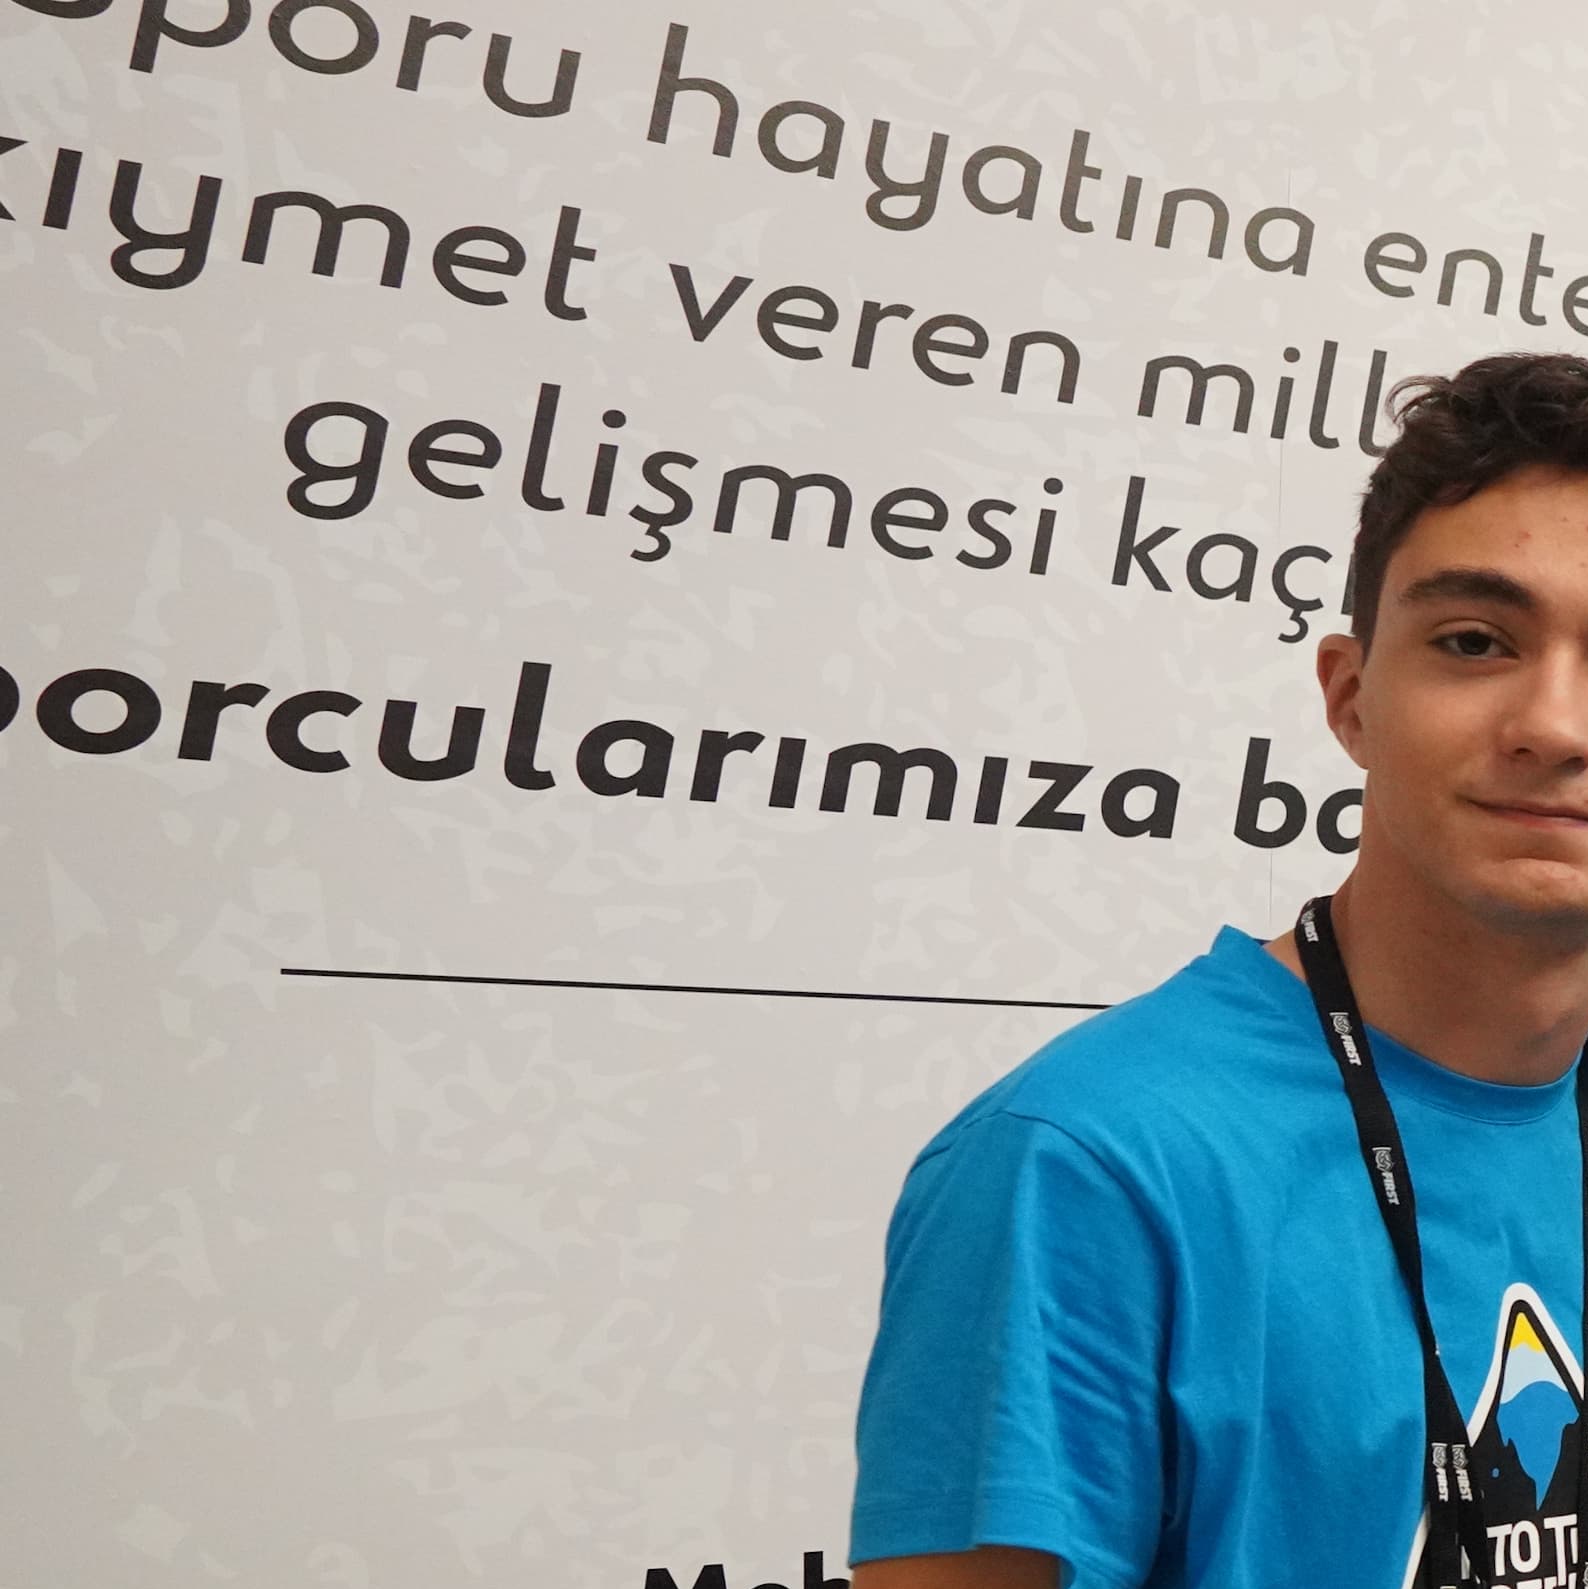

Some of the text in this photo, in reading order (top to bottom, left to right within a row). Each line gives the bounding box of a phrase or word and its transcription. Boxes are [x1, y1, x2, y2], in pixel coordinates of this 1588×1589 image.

[10, 0, 581, 118] poru
[646, 22, 1314, 276] hayatına
[668, 262, 1082, 404] veren
[283, 382, 1065, 576] gelişmesi
[1340, 1035, 1361, 1066] FIRST
[1381, 1171, 1400, 1205] FIRST
[1435, 1467, 1449, 1502] FIRST
[1458, 1468, 1473, 1502] FIRST
[1486, 1519, 1541, 1576] TO
